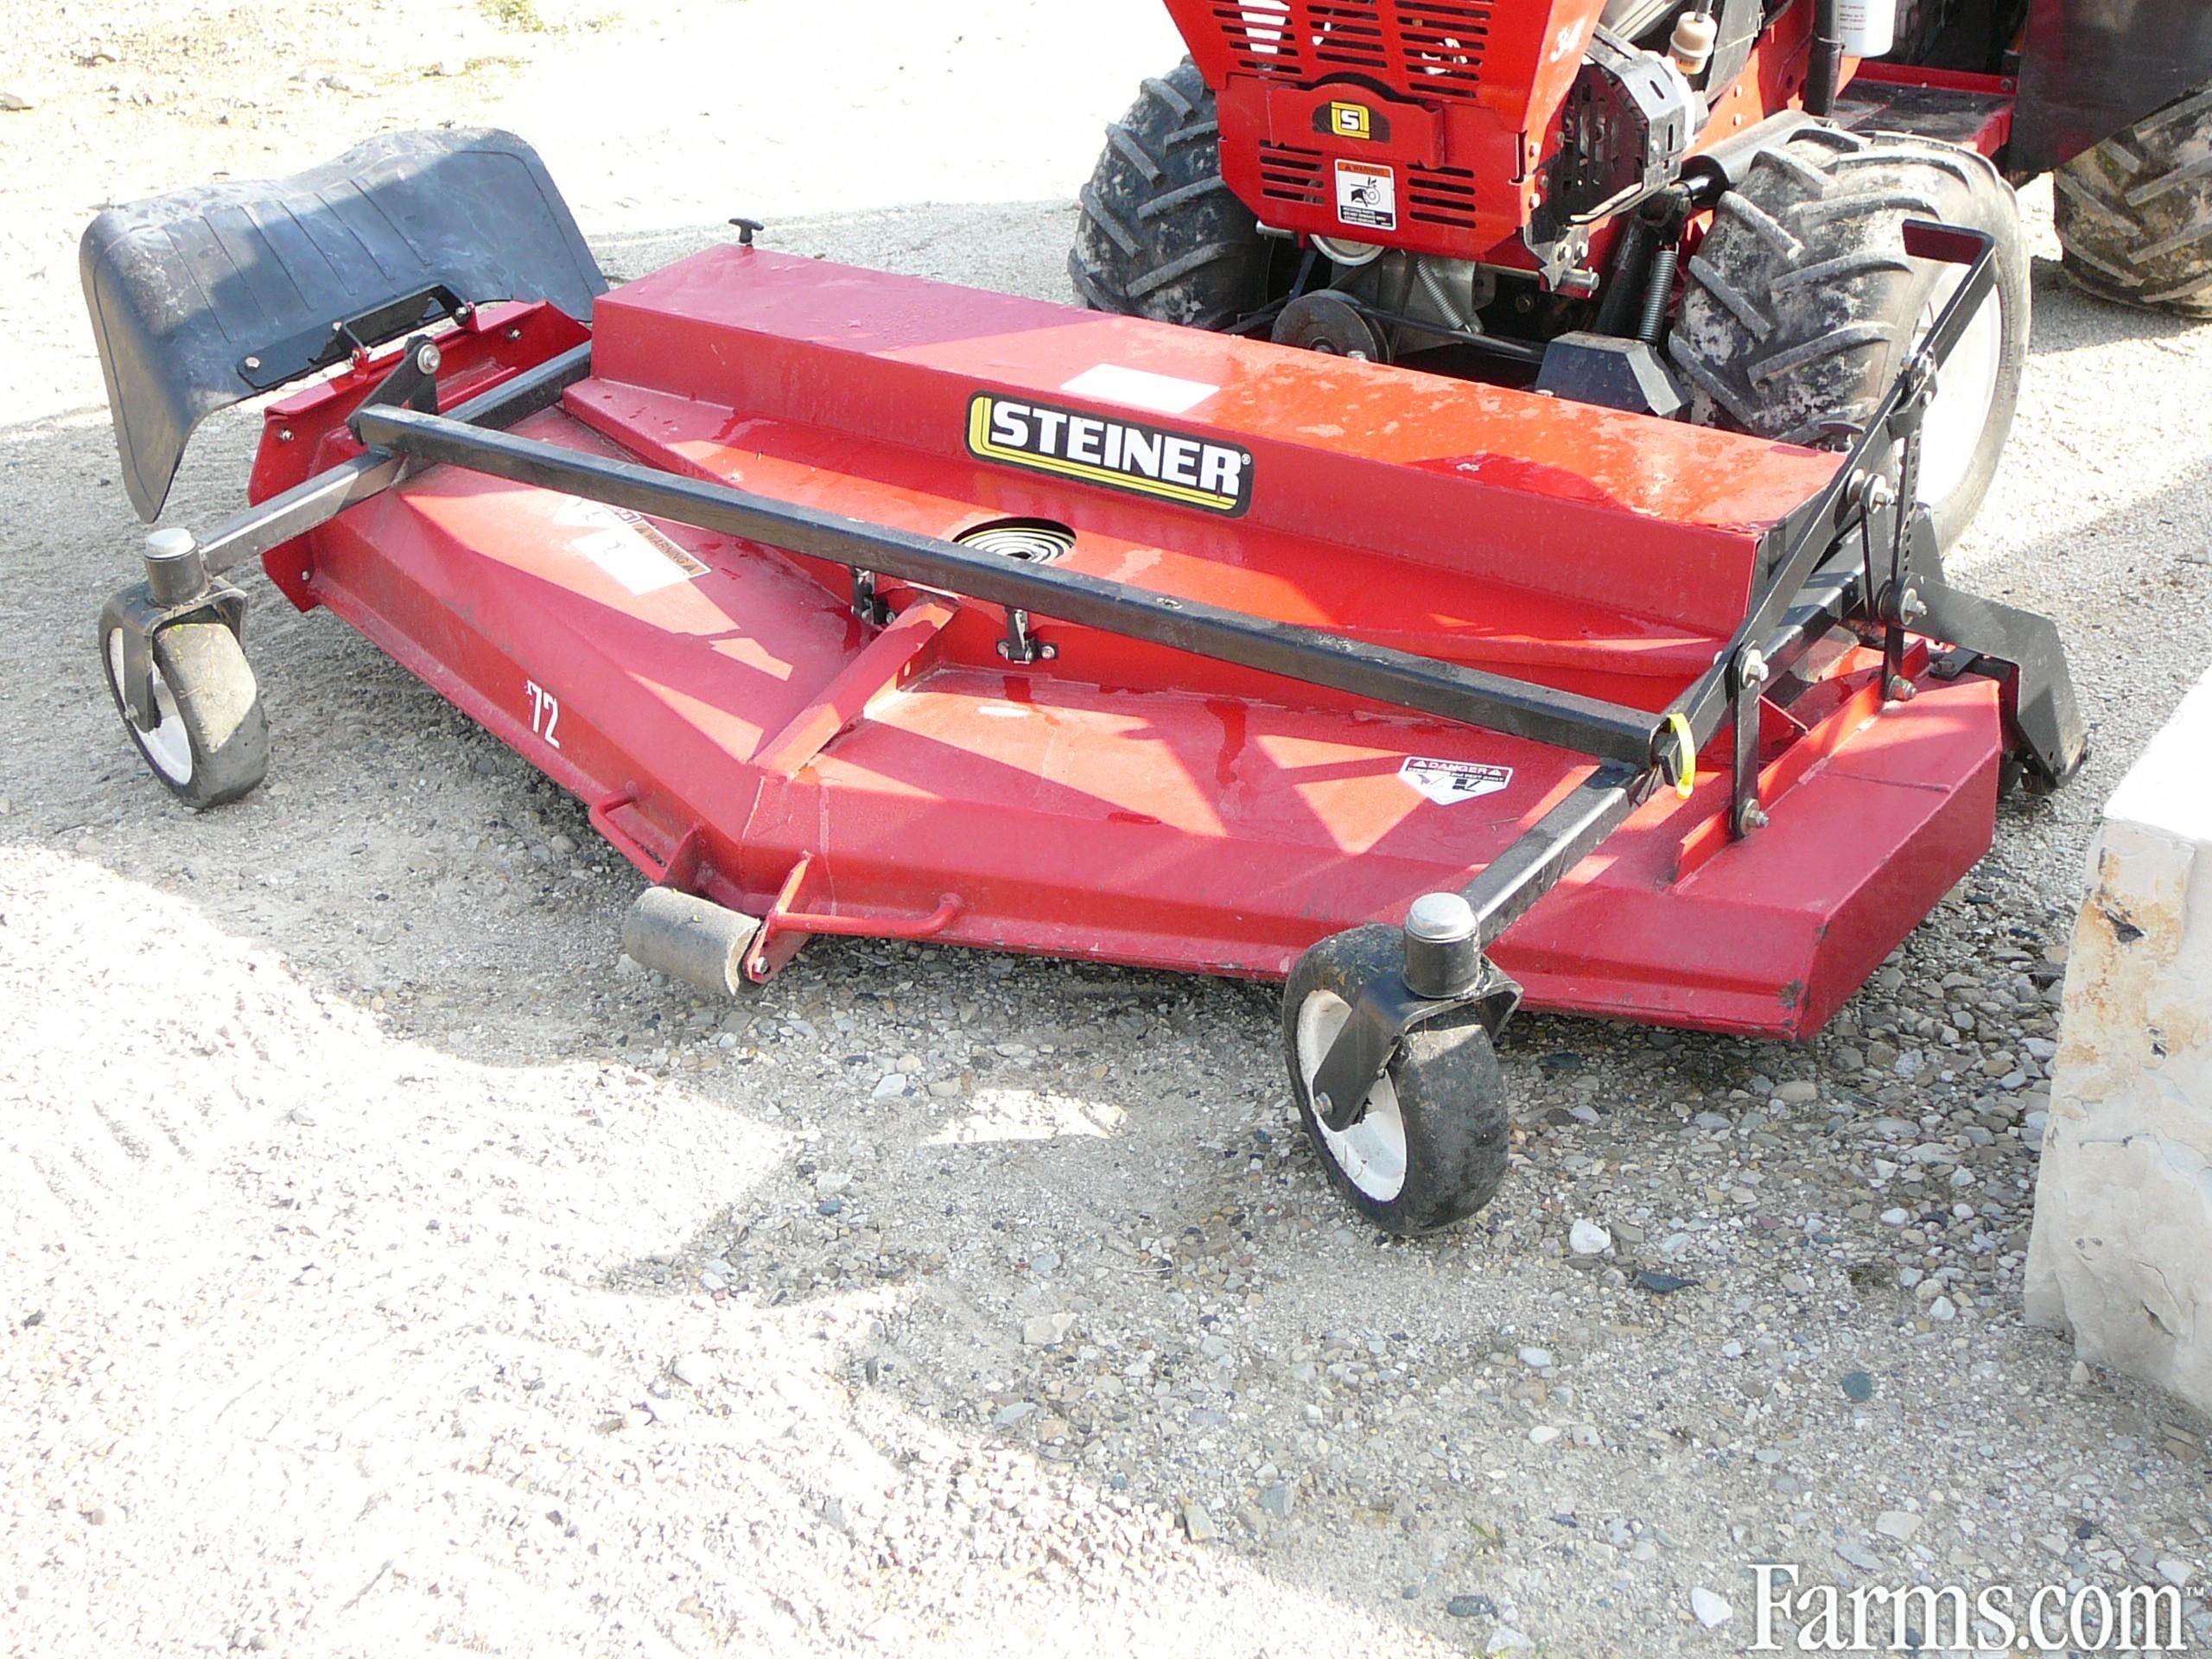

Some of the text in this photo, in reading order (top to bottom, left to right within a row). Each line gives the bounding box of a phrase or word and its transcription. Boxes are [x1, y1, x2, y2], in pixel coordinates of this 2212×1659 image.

[1341, 110, 1359, 130] S
[991, 400, 1243, 496] STEINER
[644, 531, 689, 564] WARNING
[526, 679, 560, 749] 72
[1428, 761, 1487, 774] DANGER
